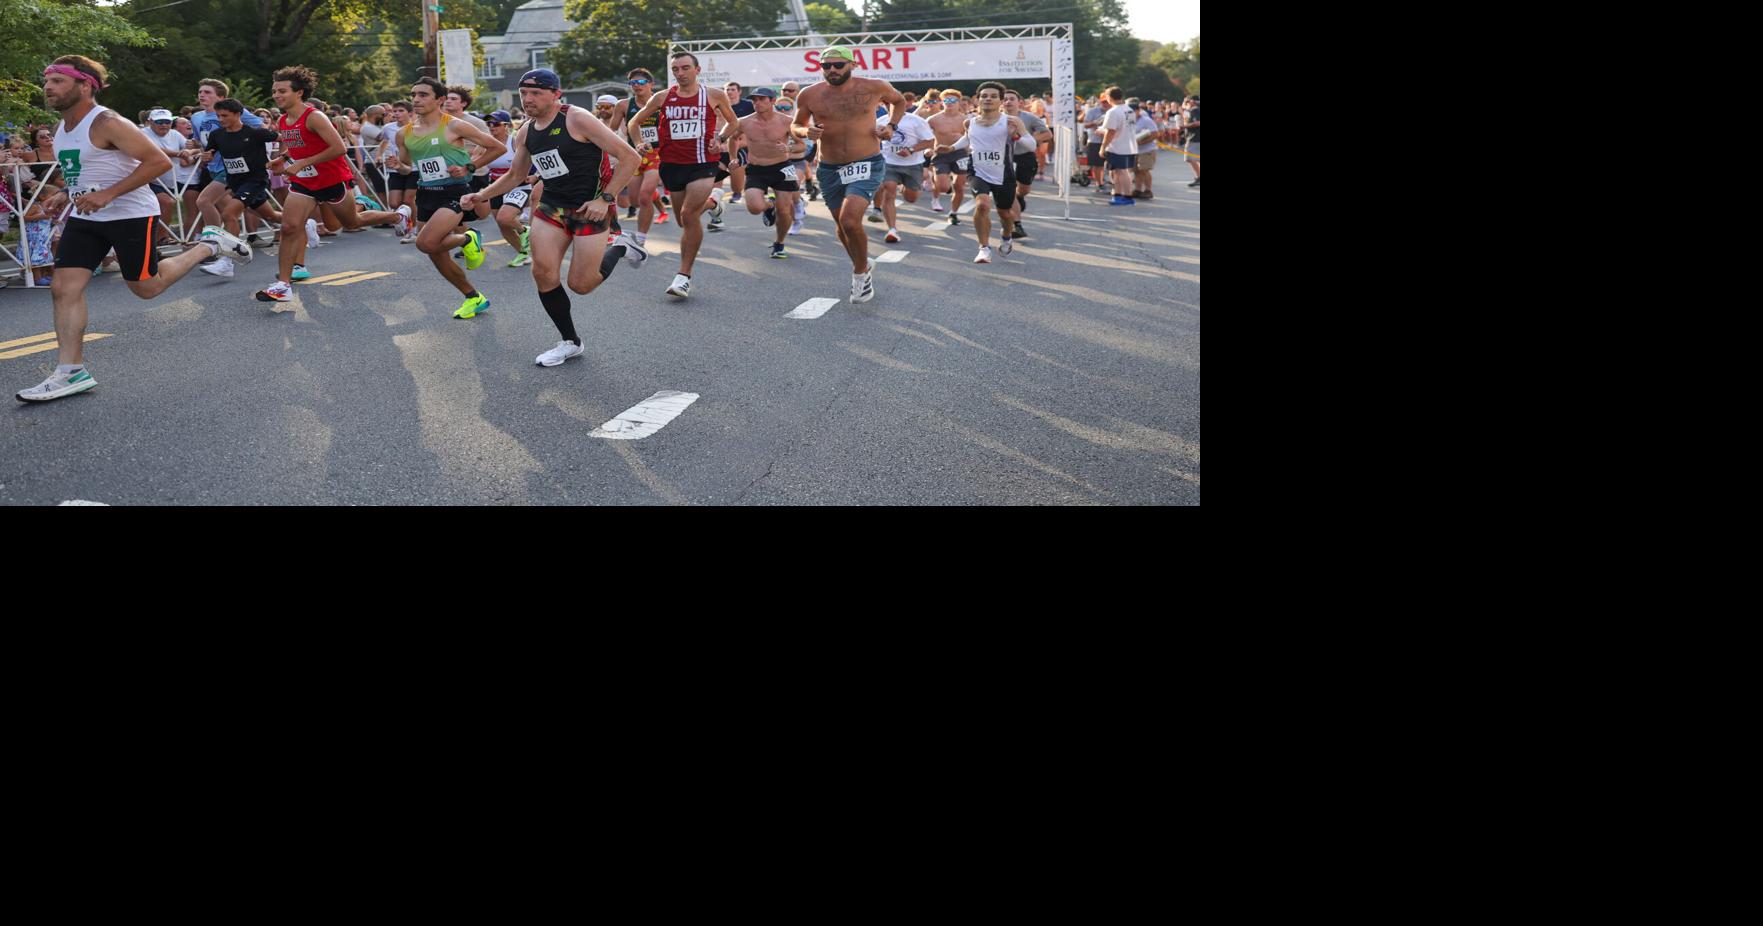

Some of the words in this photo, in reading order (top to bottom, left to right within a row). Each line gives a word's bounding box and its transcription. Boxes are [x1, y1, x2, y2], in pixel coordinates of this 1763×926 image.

[804, 47, 916, 73] SART
[665, 105, 706, 119] NOTCH
[671, 122, 698, 134] 2177
[535, 153, 560, 171] 1681
[977, 151, 1000, 161] 1145
[421, 160, 441, 175] 490
[843, 163, 868, 177] 1815
[505, 190, 526, 201] 1527
